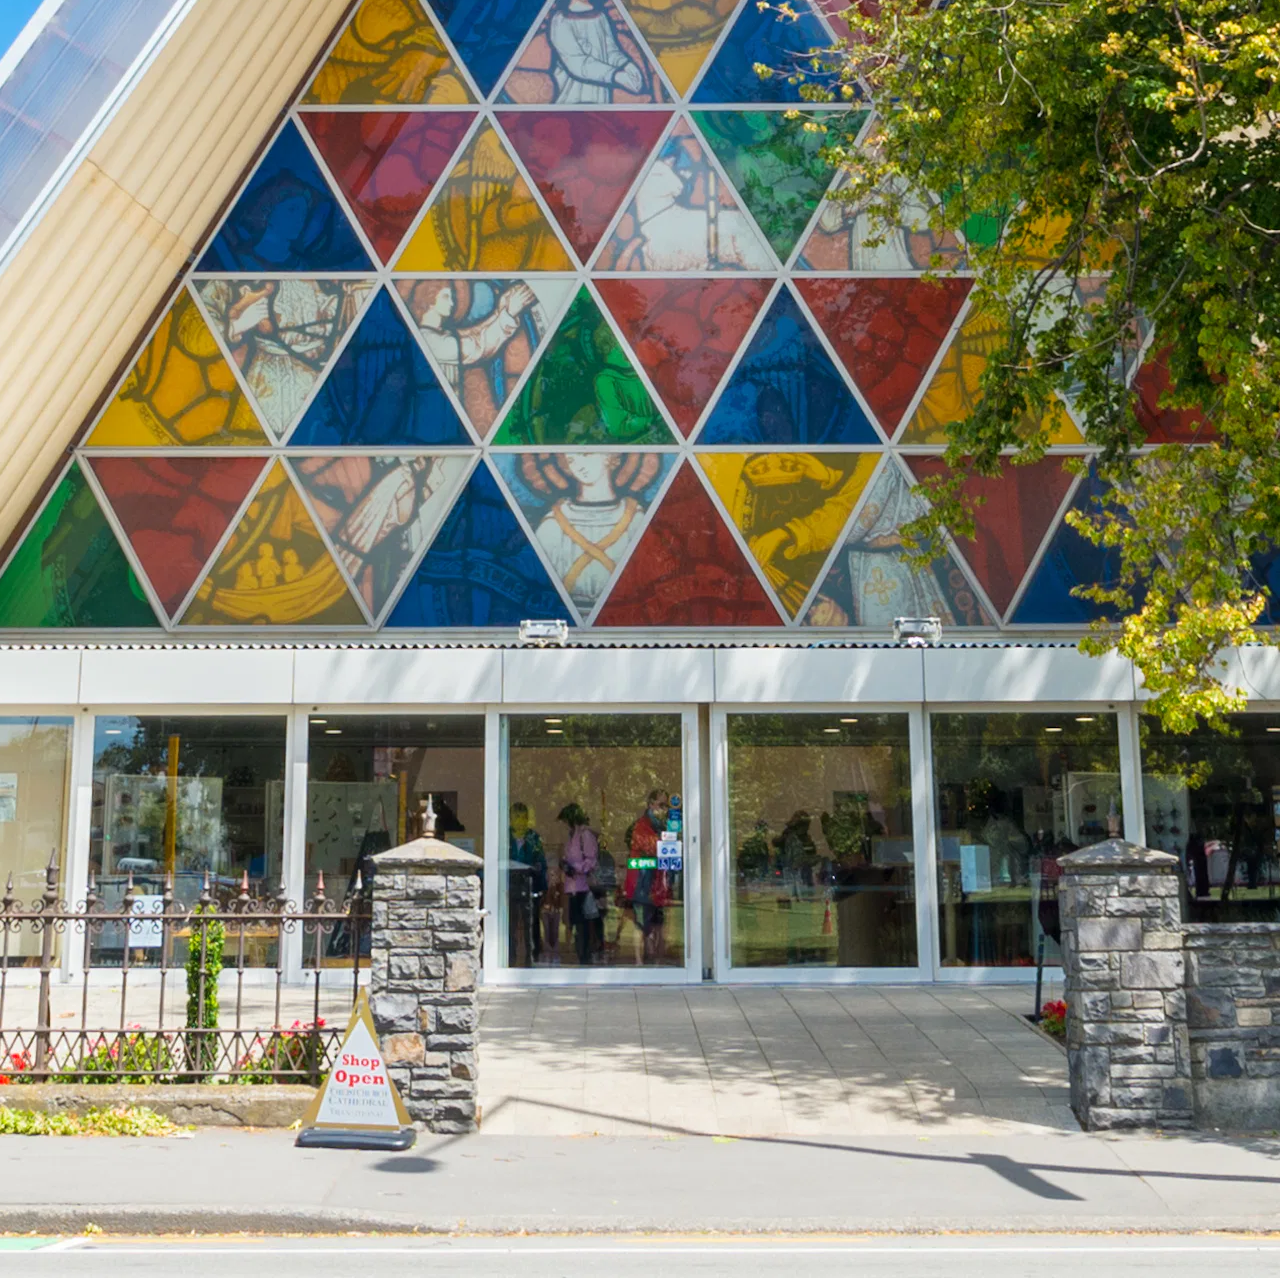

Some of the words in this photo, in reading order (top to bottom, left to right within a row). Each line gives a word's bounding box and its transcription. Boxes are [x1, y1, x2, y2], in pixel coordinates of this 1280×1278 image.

[342, 1054, 380, 1070] Shop
[335, 1070, 384, 1087] Open
[329, 1097, 388, 1107] CATHEDRAL
